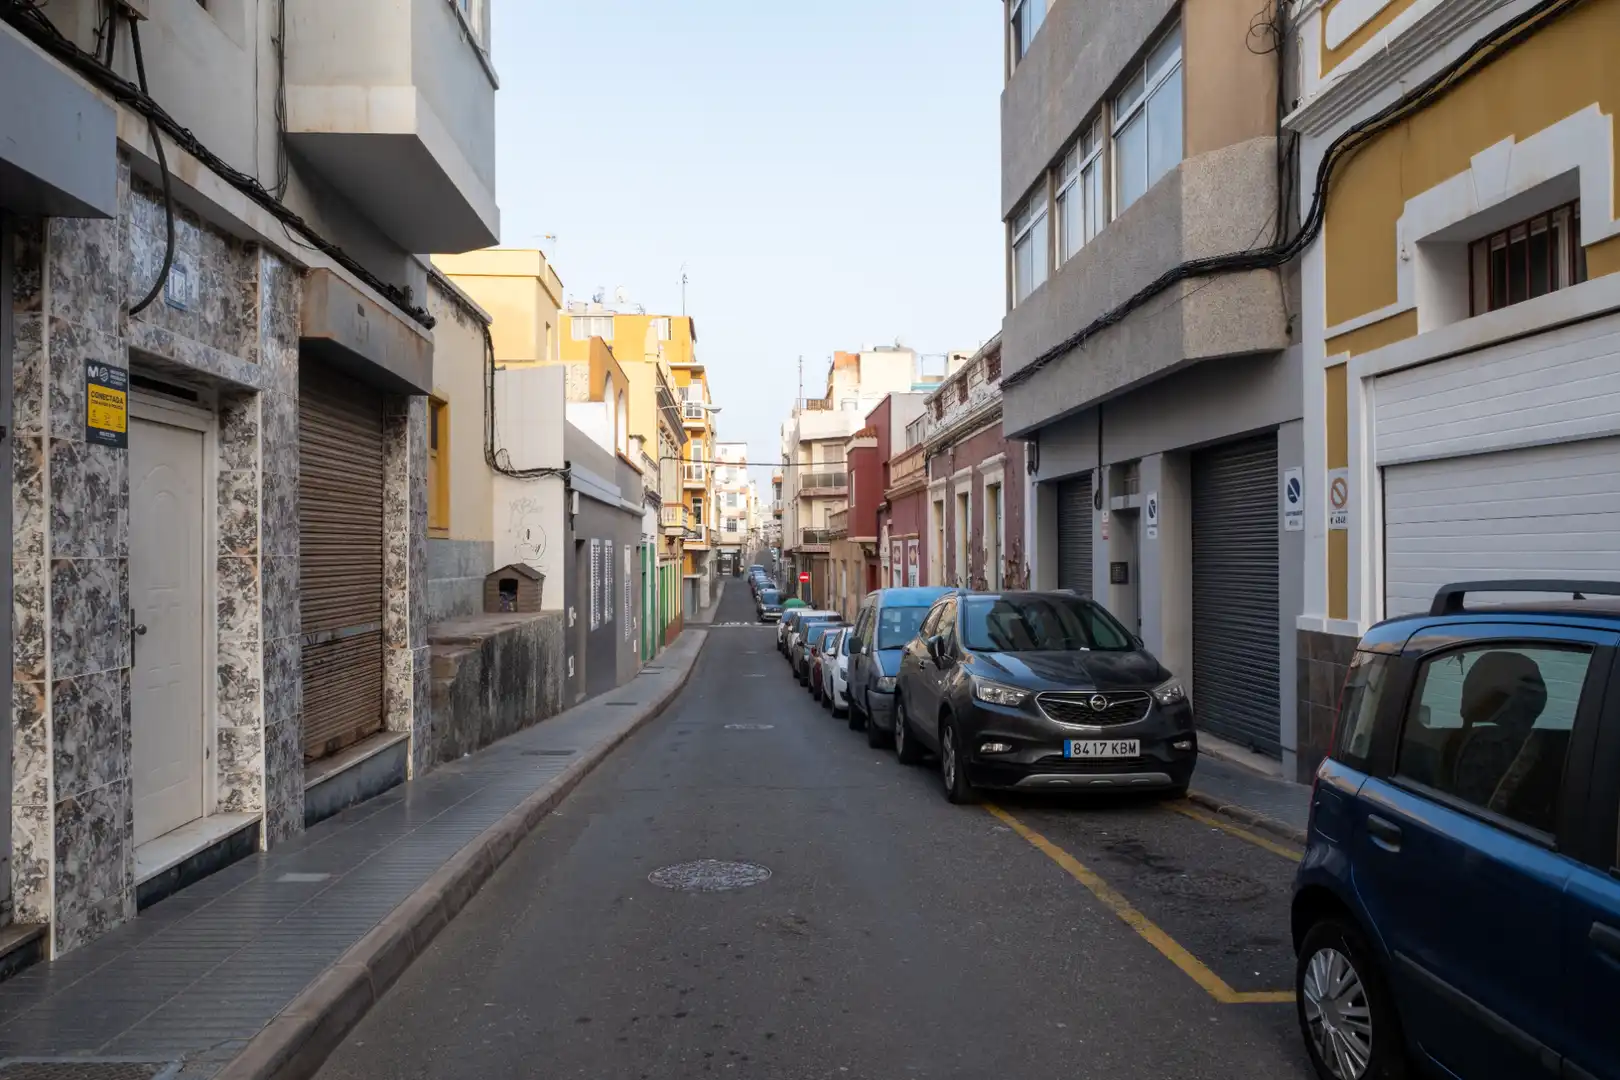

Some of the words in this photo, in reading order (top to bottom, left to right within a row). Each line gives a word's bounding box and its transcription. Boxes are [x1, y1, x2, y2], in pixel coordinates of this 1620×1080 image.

[91, 391, 124, 404] CONECTADA
[1073, 742, 1108, 755] 8417
[1111, 741, 1137, 755] KBM
